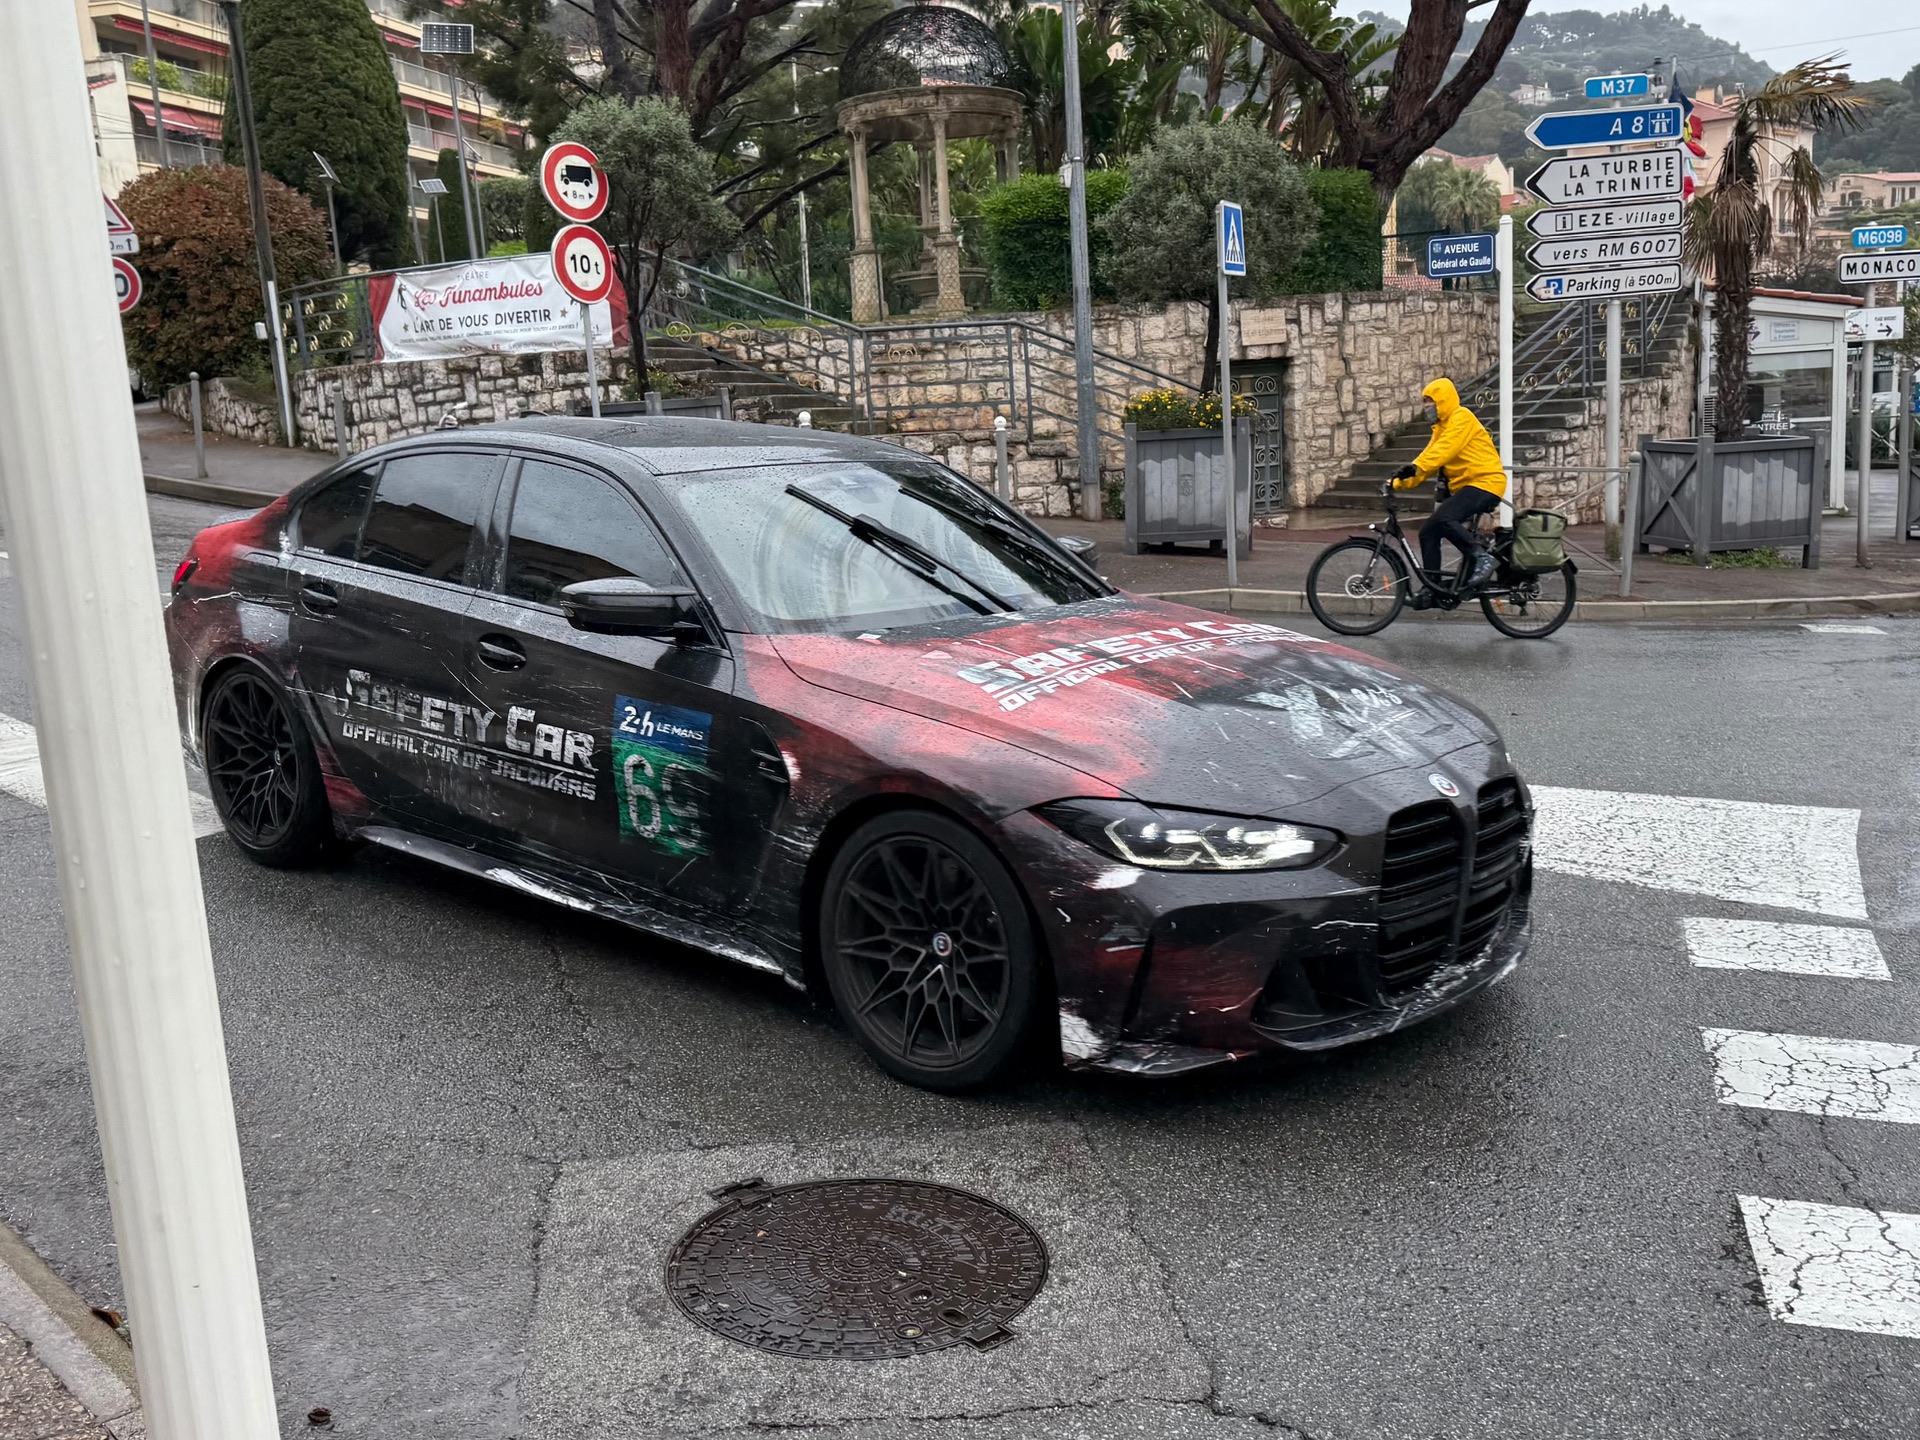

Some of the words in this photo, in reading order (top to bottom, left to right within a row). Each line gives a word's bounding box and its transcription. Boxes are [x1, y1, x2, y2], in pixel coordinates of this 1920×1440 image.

[1601, 79, 1635, 95] M37
[1569, 164, 1590, 178] LA
[1602, 156, 1674, 176] TURBIE
[1564, 182, 1585, 197] LA
[1596, 171, 1674, 194] TRINITÉ
[1444, 242, 1480, 255] AVENUE
[1858, 230, 1903, 245] M6098
[1431, 259, 1458, 270] Général
[1459, 258, 1468, 267] de
[1469, 255, 1492, 267] Gaulle
[1553, 248, 1588, 260] vers
[1846, 259, 1916, 276] MONACO
[414, 288, 437, 311] Les
[440, 280, 543, 308] Funambules
[1567, 277, 1621, 292] Parking
[413, 317, 435, 334] L'ART
[438, 317, 453, 331] DE
[458, 314, 489, 329] VOUS
[495, 309, 551, 325] DIVERTIR
[957, 627, 1195, 694] SAFETY
[999, 658, 1131, 712] OFFICIAL
[1127, 645, 1186, 664] CAR
[1181, 641, 1216, 652] OF
[345, 669, 496, 743] SAFETY
[506, 705, 599, 771] CAR
[343, 721, 418, 754] OFFICIAL
[422, 740, 459, 765] CAR
[462, 751, 488, 770] OF
